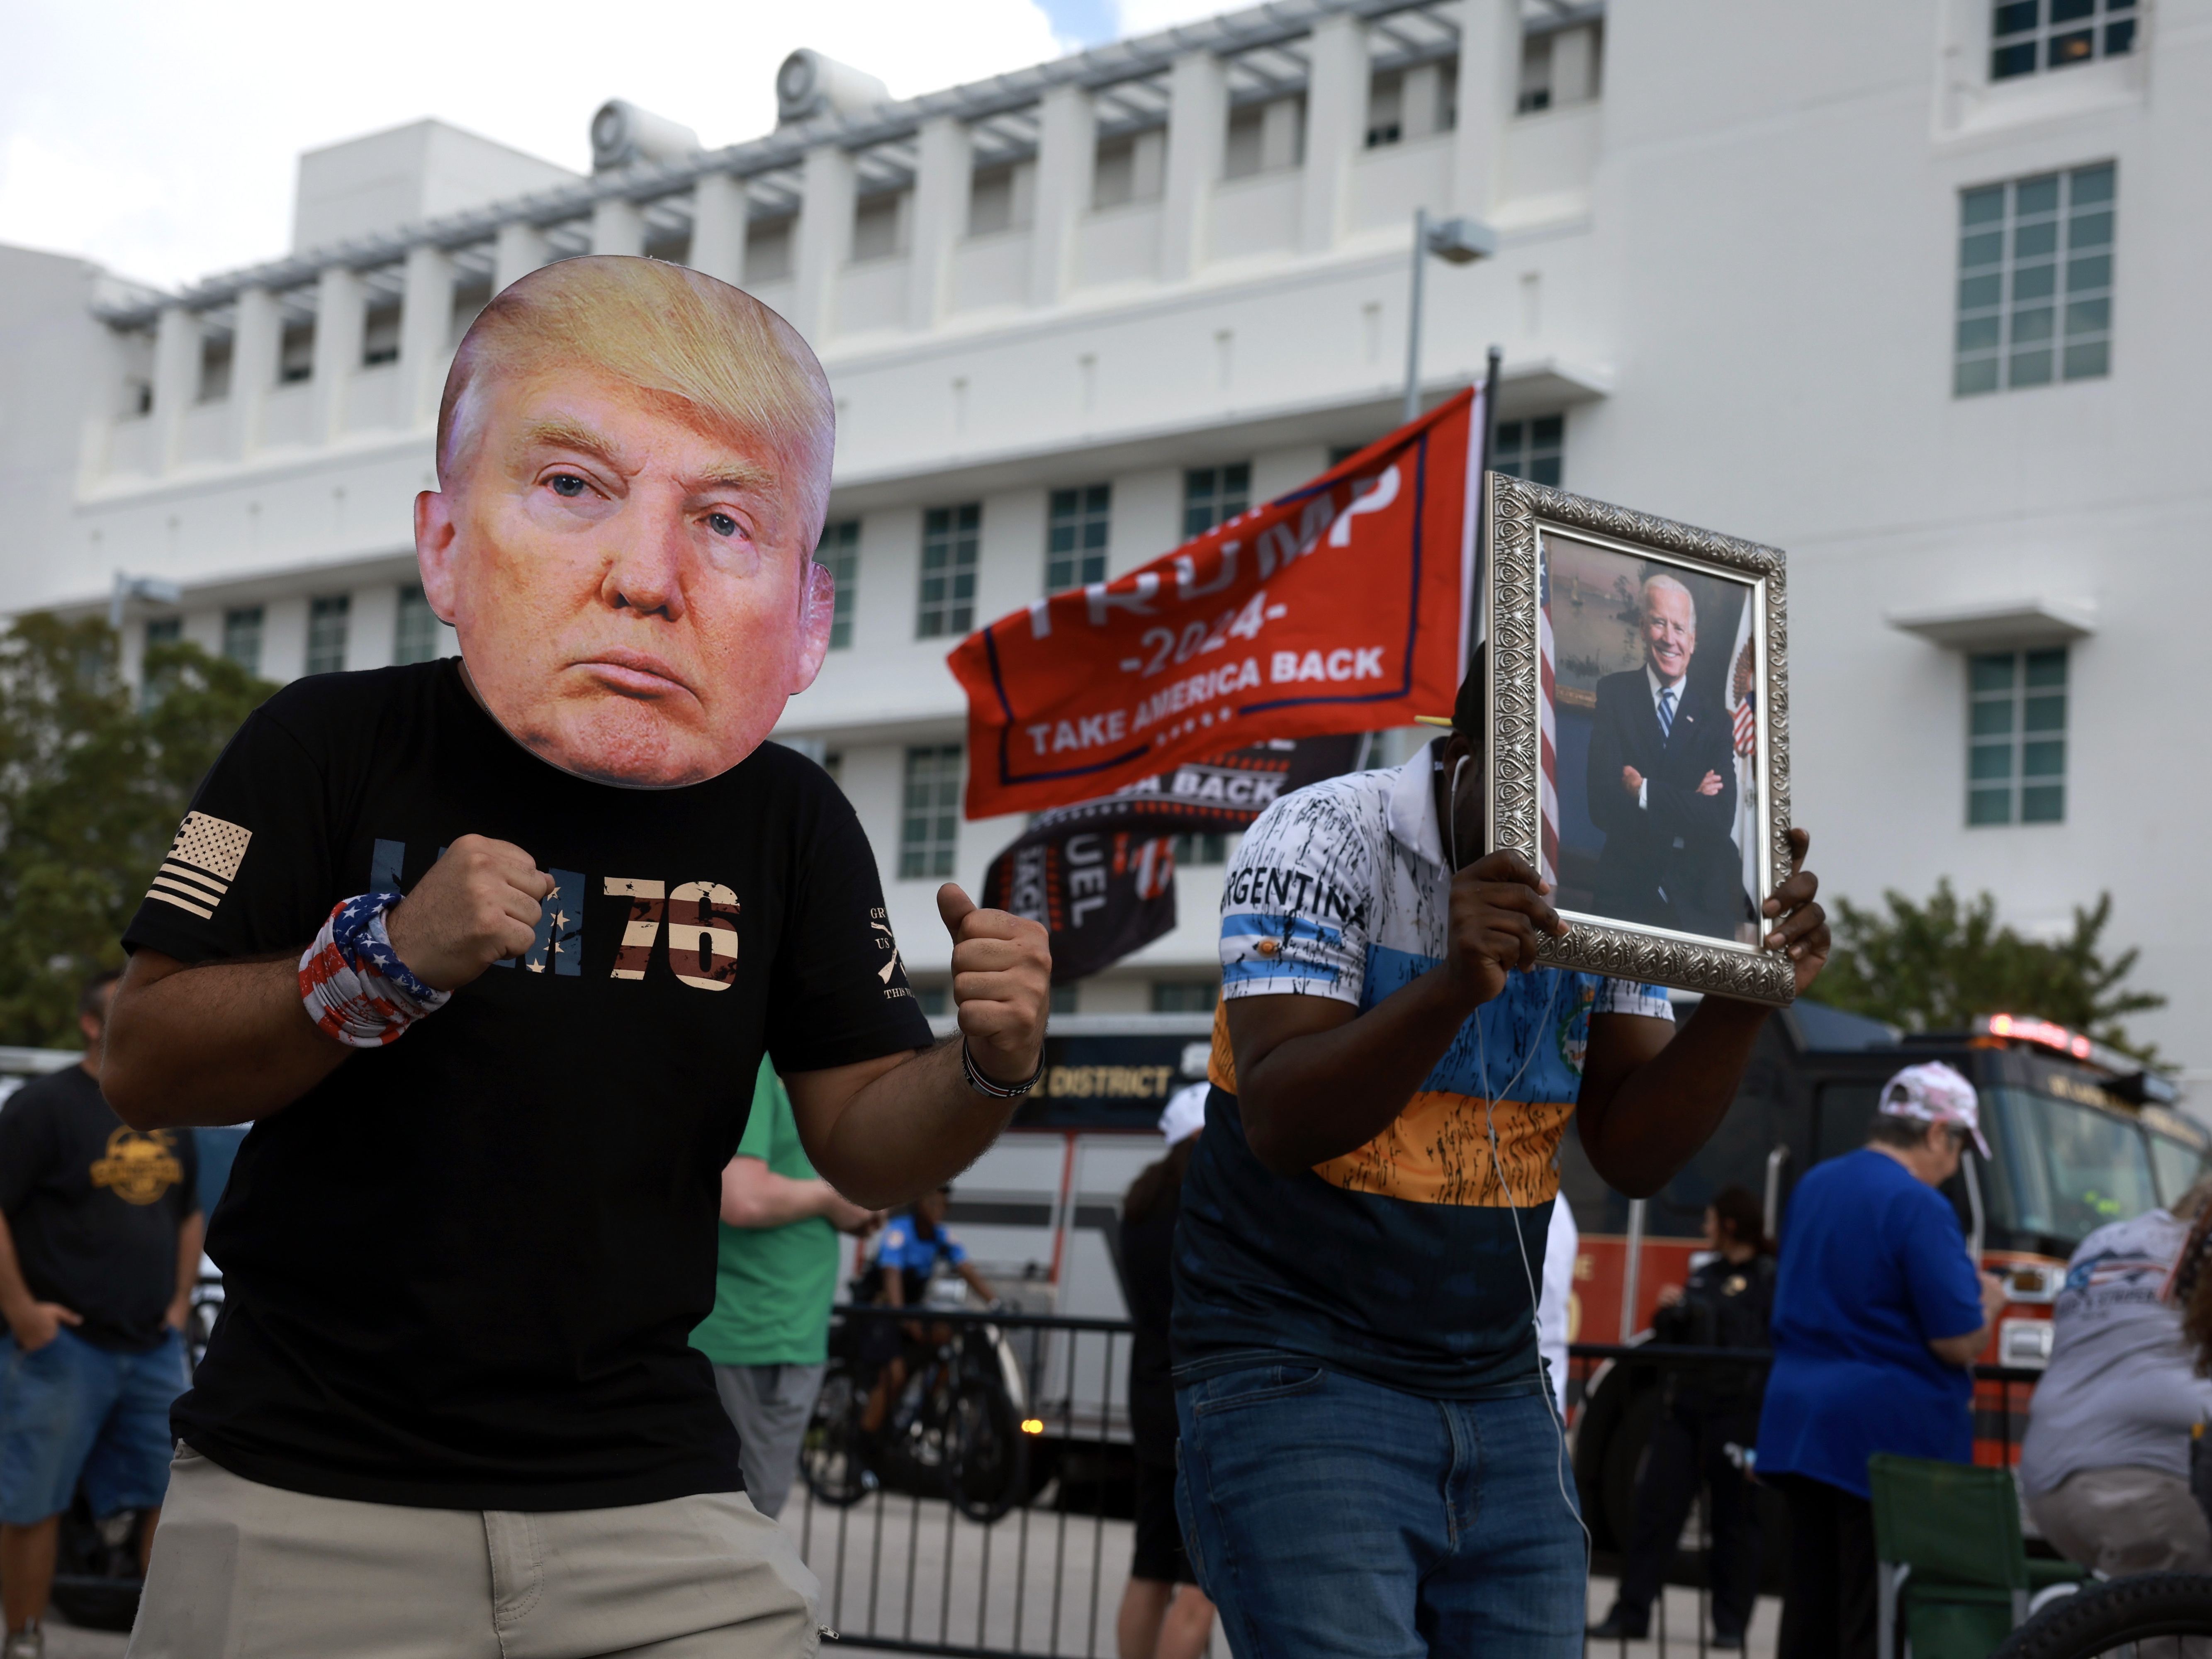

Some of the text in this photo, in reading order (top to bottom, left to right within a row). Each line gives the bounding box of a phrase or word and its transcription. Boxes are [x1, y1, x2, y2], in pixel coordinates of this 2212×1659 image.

[1029, 464, 1401, 640] TRUMP
[1026, 646, 1385, 755] TAKE AMERICA BACK
[1171, 769, 1285, 805] BACK
[604, 876, 741, 992] 76
[1048, 1065, 1173, 1098] DISTRICT
